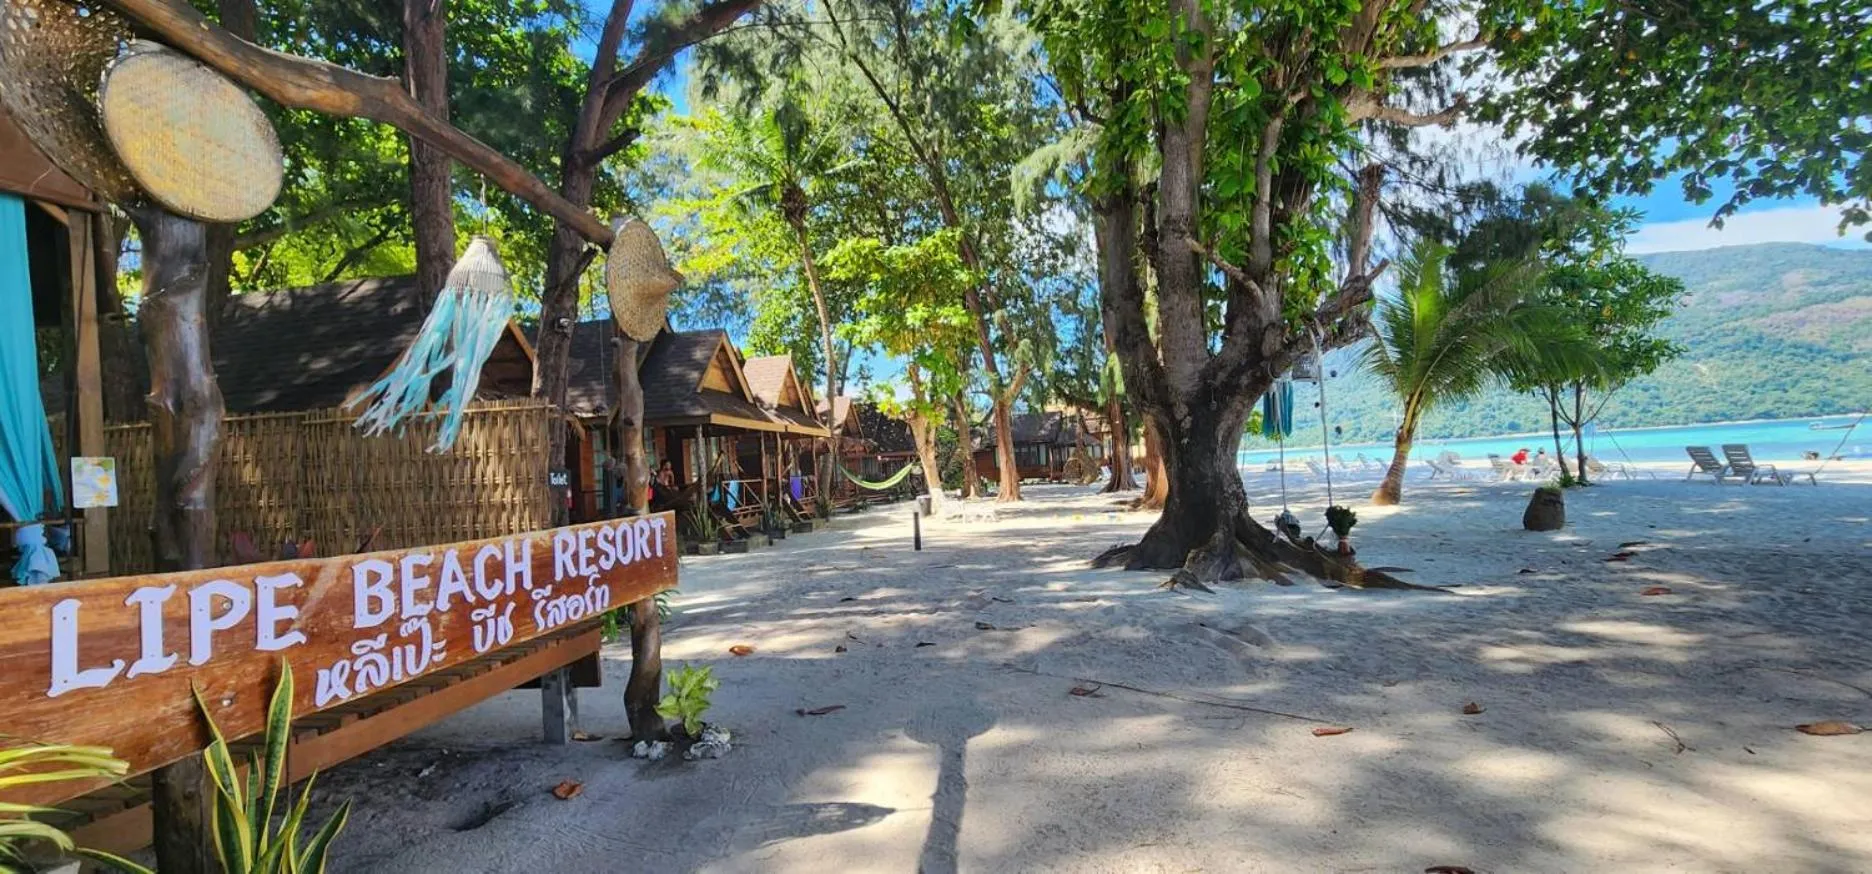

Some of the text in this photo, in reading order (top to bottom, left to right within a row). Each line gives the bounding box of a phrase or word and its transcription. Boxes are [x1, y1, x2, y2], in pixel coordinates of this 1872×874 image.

[46, 516, 667, 698] LIPE BEACH RESORT
[314, 573, 610, 708] หลีเป๊ะ บีช รีสอร์ท
